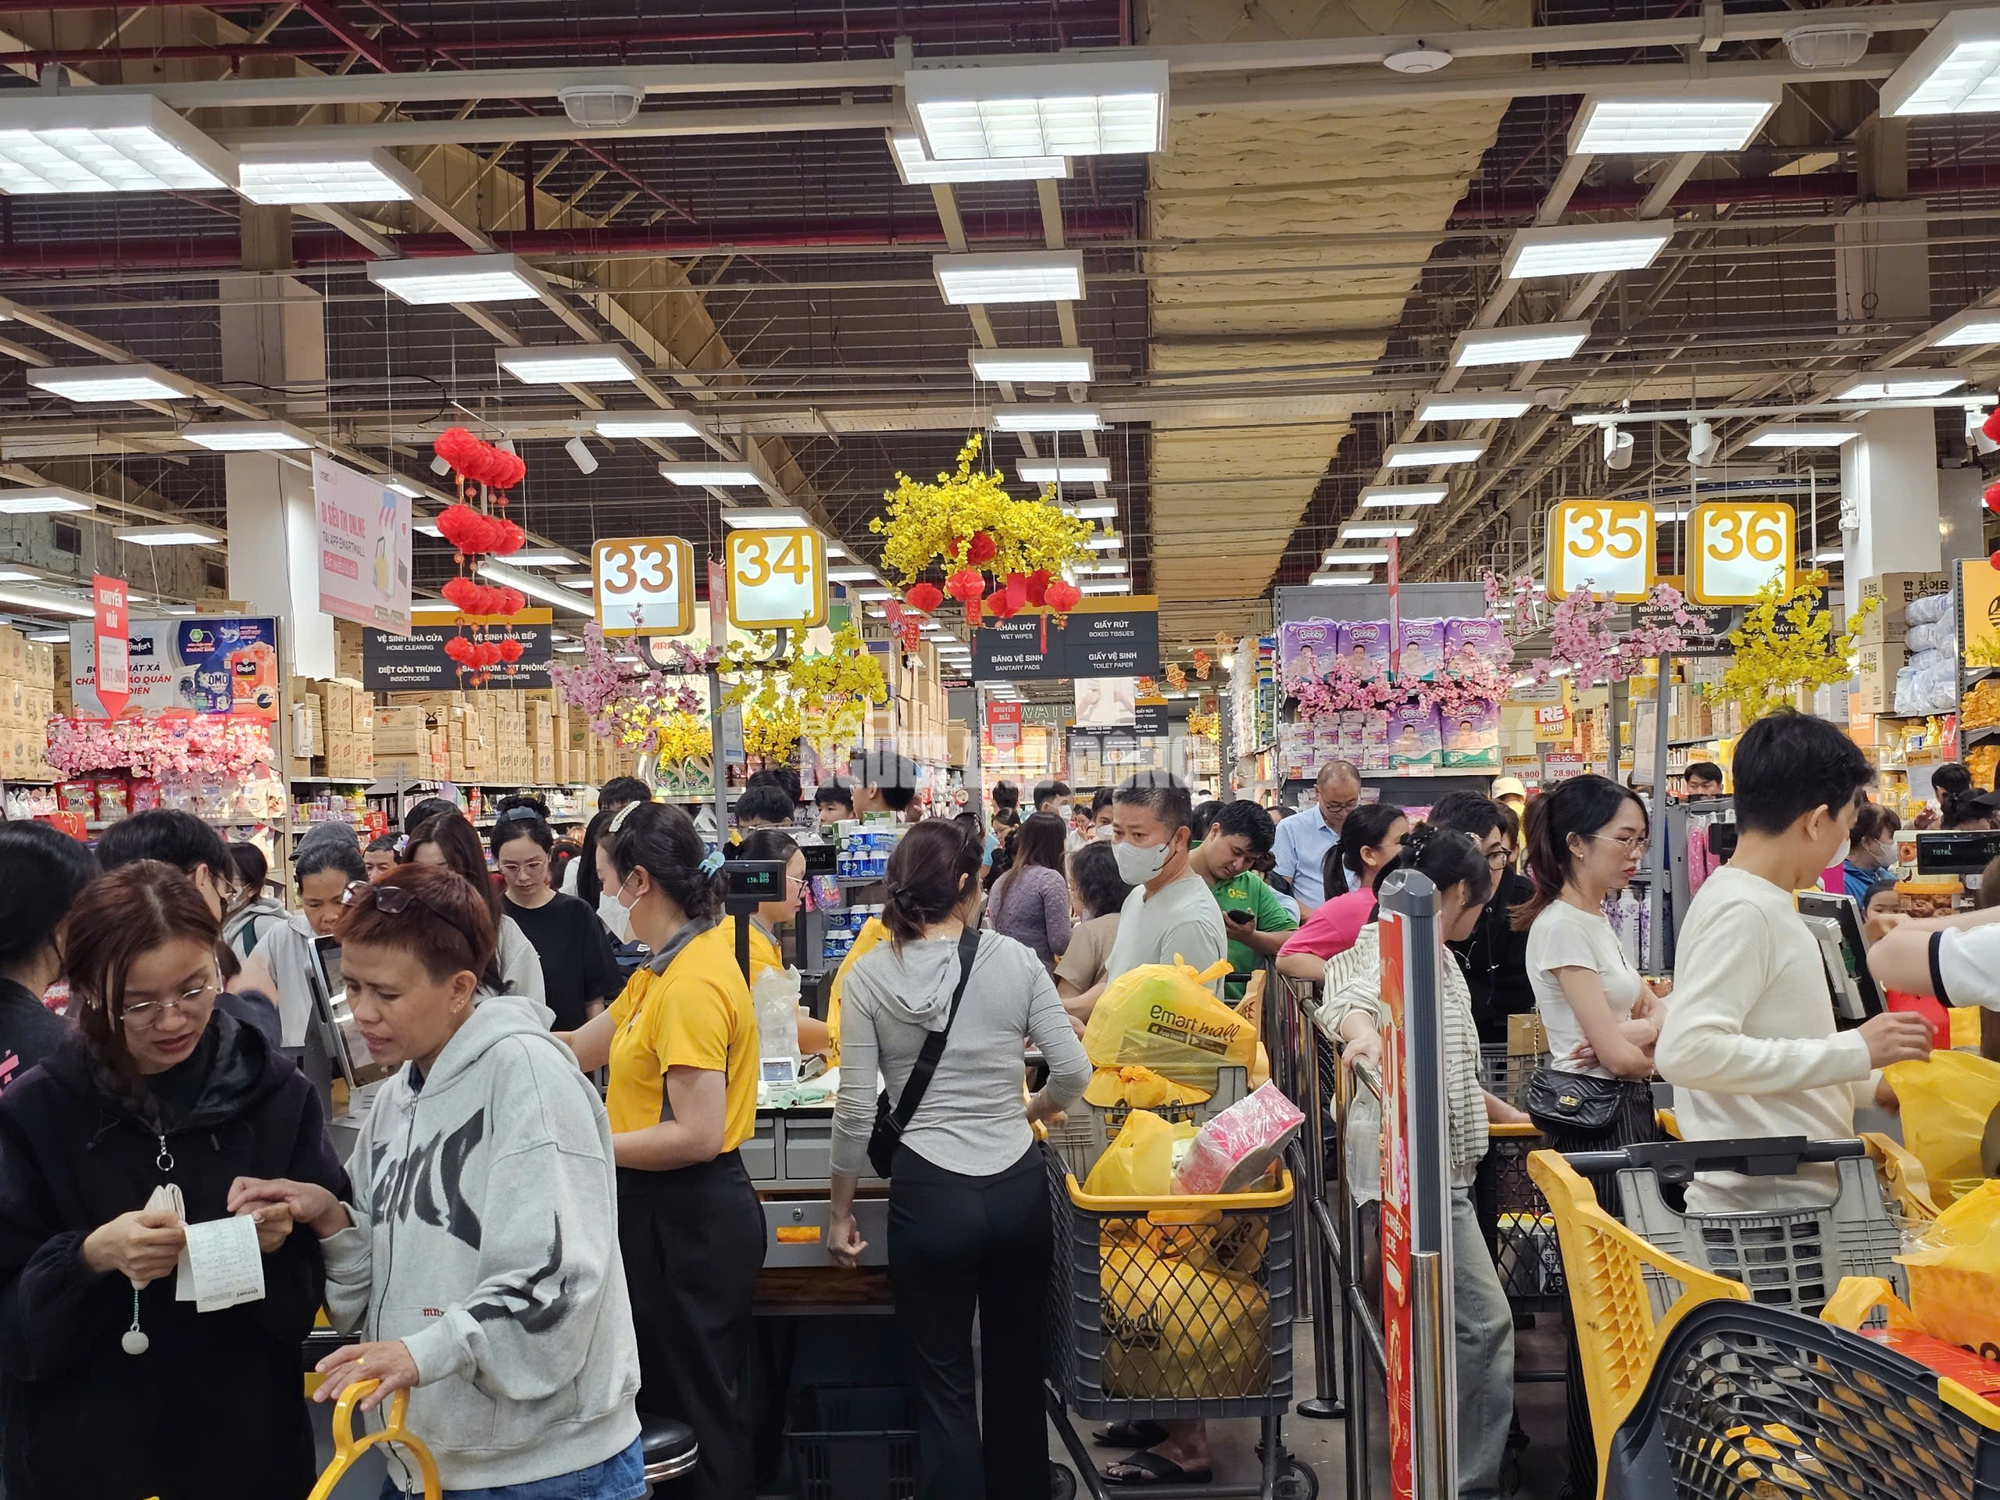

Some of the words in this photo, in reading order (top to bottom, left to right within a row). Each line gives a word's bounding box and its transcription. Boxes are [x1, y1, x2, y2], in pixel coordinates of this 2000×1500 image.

[1568, 506, 1642, 558] 35
[1707, 508, 1783, 561] 36
[737, 535, 810, 584] 34
[604, 545, 673, 594] 33
[100, 588, 122, 607] KHUYẾN
[1094, 620, 1112, 629] GIẤY
[1114, 620, 1129, 628] RÚT
[377, 635, 387, 644] VỆ
[426, 634, 443, 642] CỬA
[504, 632, 521, 640] NHÀ
[522, 631, 537, 640] BẾP
[128, 640, 152, 654] omfort
[991, 654, 1012, 663] BĂNG
[1014, 653, 1024, 663] VỆ
[1088, 651, 1107, 661] GIẤY
[1108, 652, 1118, 661] VỆ
[1119, 652, 1137, 660] SINH
[378, 664, 396, 674] DIỆT
[397, 664, 414, 673] CÔN
[415, 664, 442, 673] TRÙNG
[209, 675, 228, 685] OMO
[1553, 769, 1582, 777] 28.900
[1150, 1004, 1198, 1032] emart
[1198, 1022, 1240, 1043] mall
